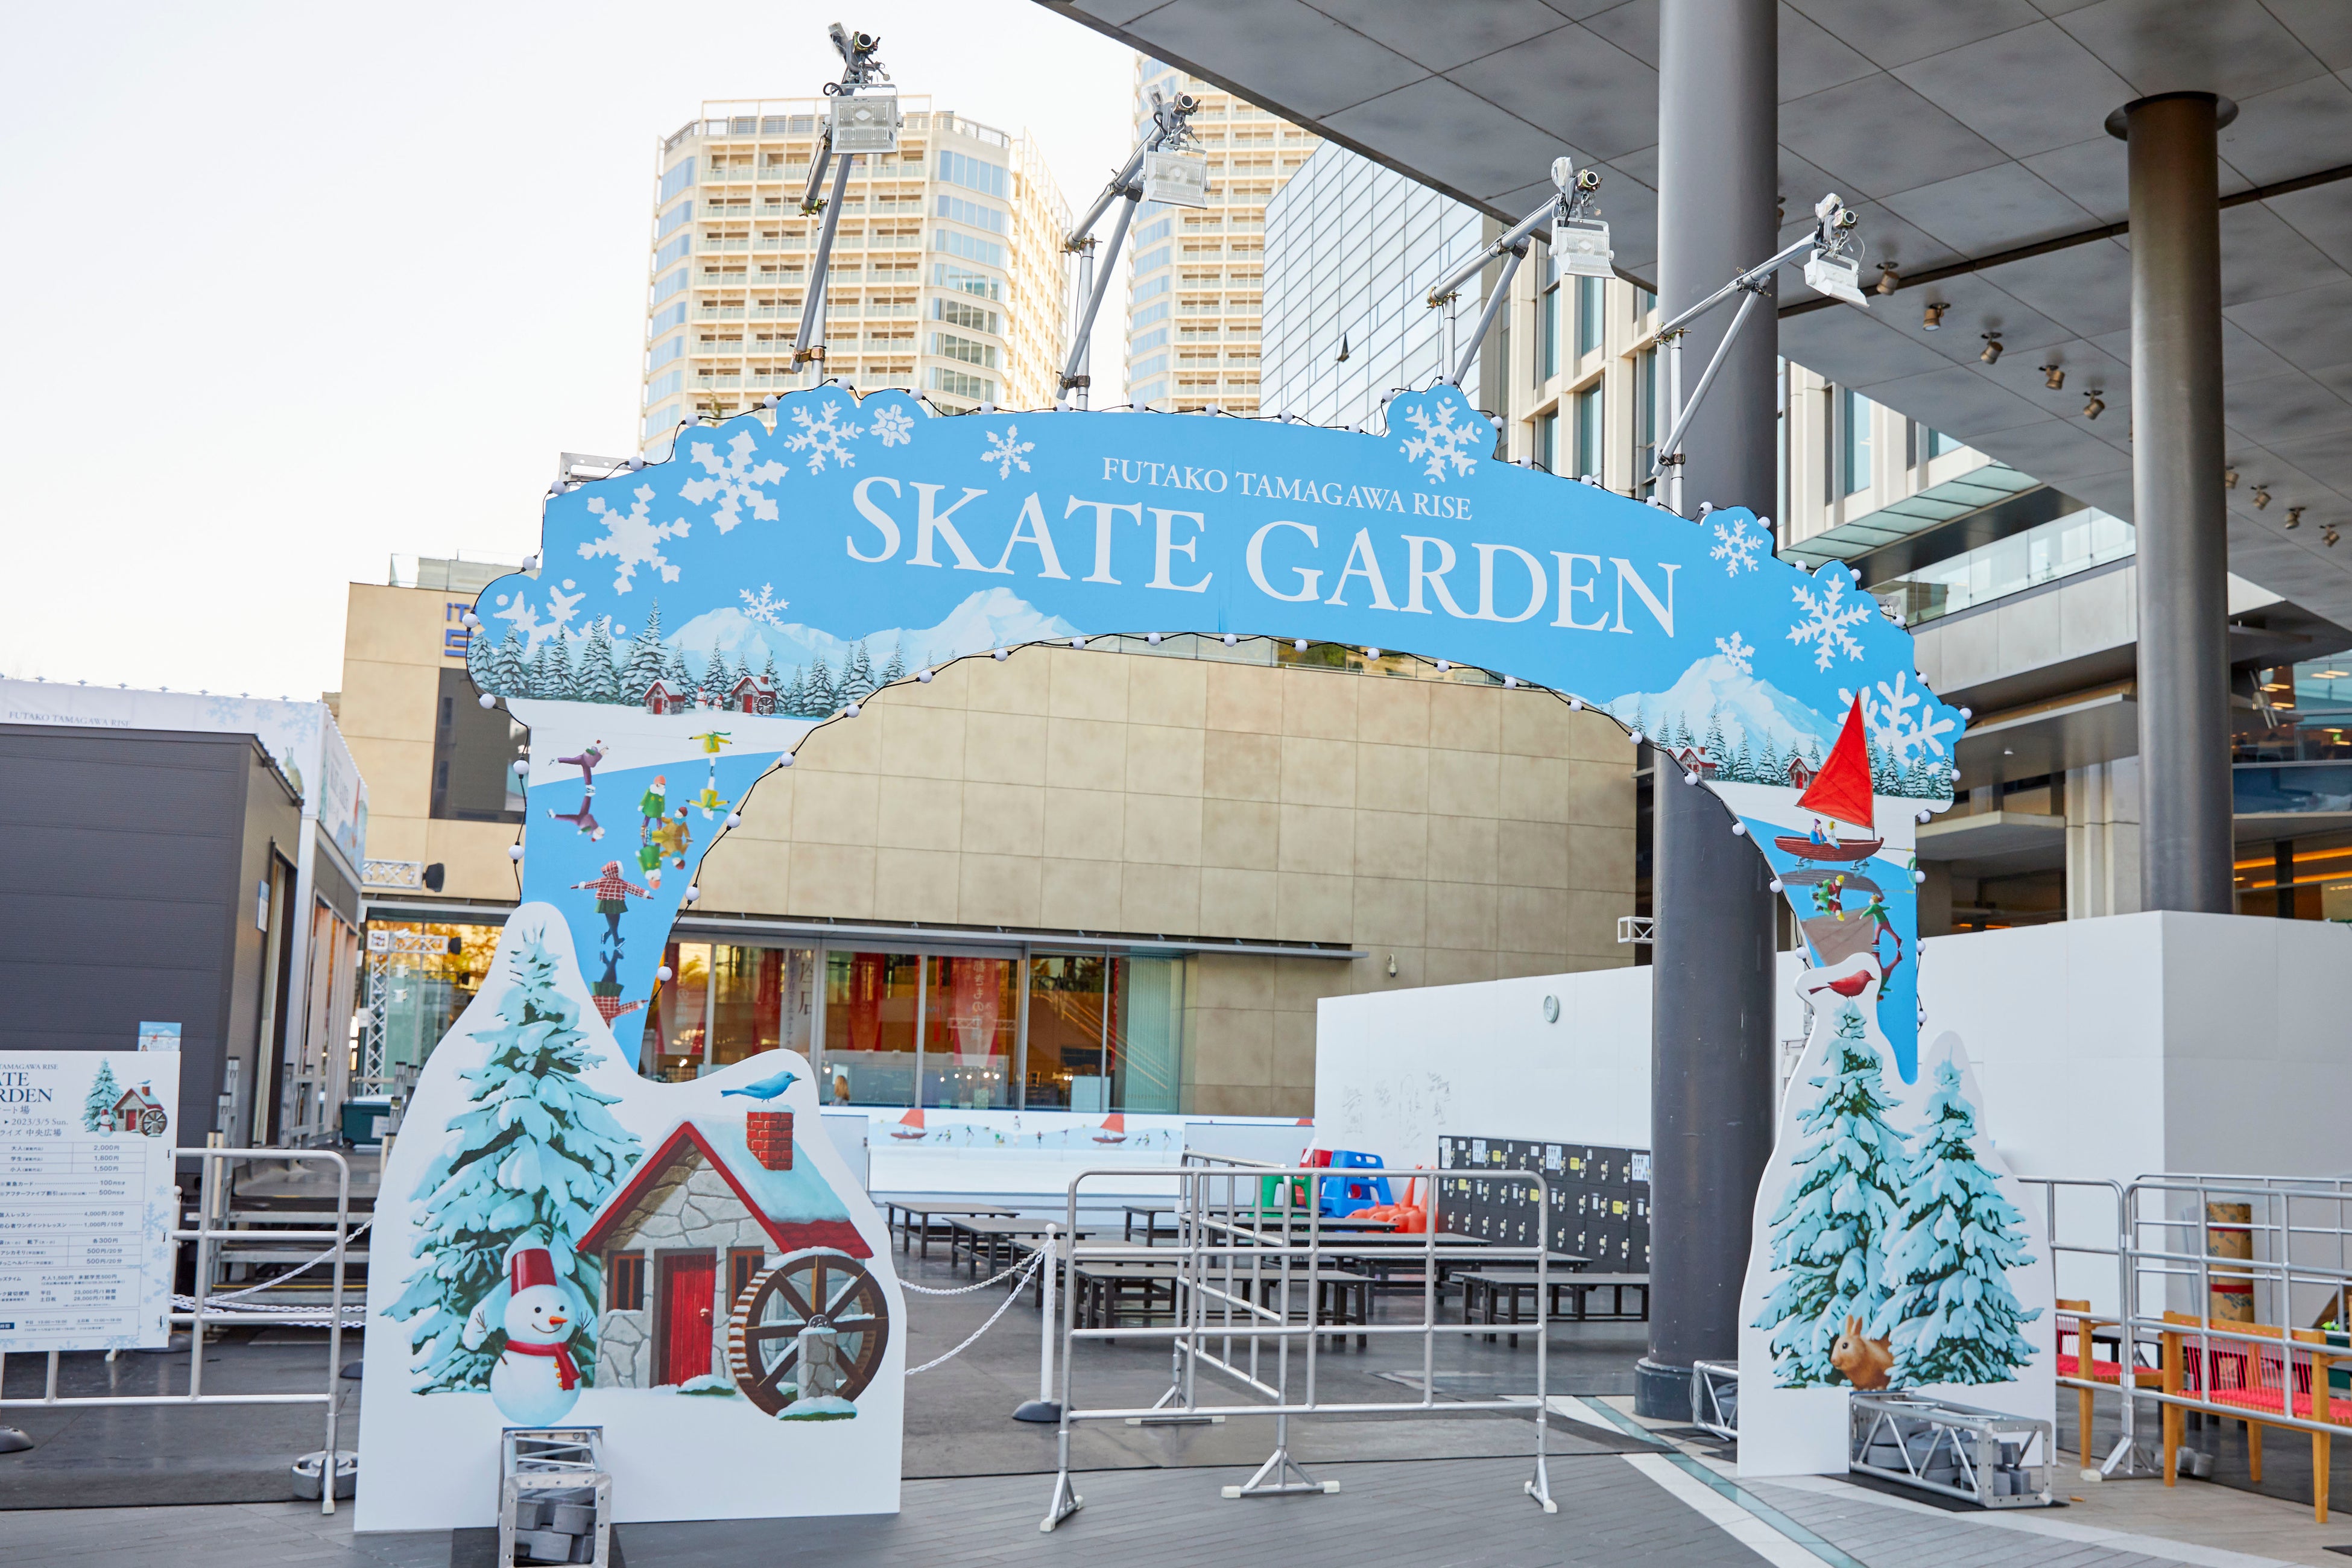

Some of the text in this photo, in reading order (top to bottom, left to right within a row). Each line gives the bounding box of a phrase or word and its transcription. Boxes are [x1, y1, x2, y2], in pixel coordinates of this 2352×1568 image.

[1102, 457, 1473, 521] FUTAKO TAMAGAWA RISE
[847, 476, 1682, 638] SKATE GARDEN
[9, 711, 131, 727] FUTAKO TAMAGAWA RISE
[0, 1072, 30, 1086] TE
[0, 1105, 30, 1114] ート場
[11, 1118, 68, 1126] 2023/3/5 Sun.
[26, 1128, 62, 1137] 中央広場
